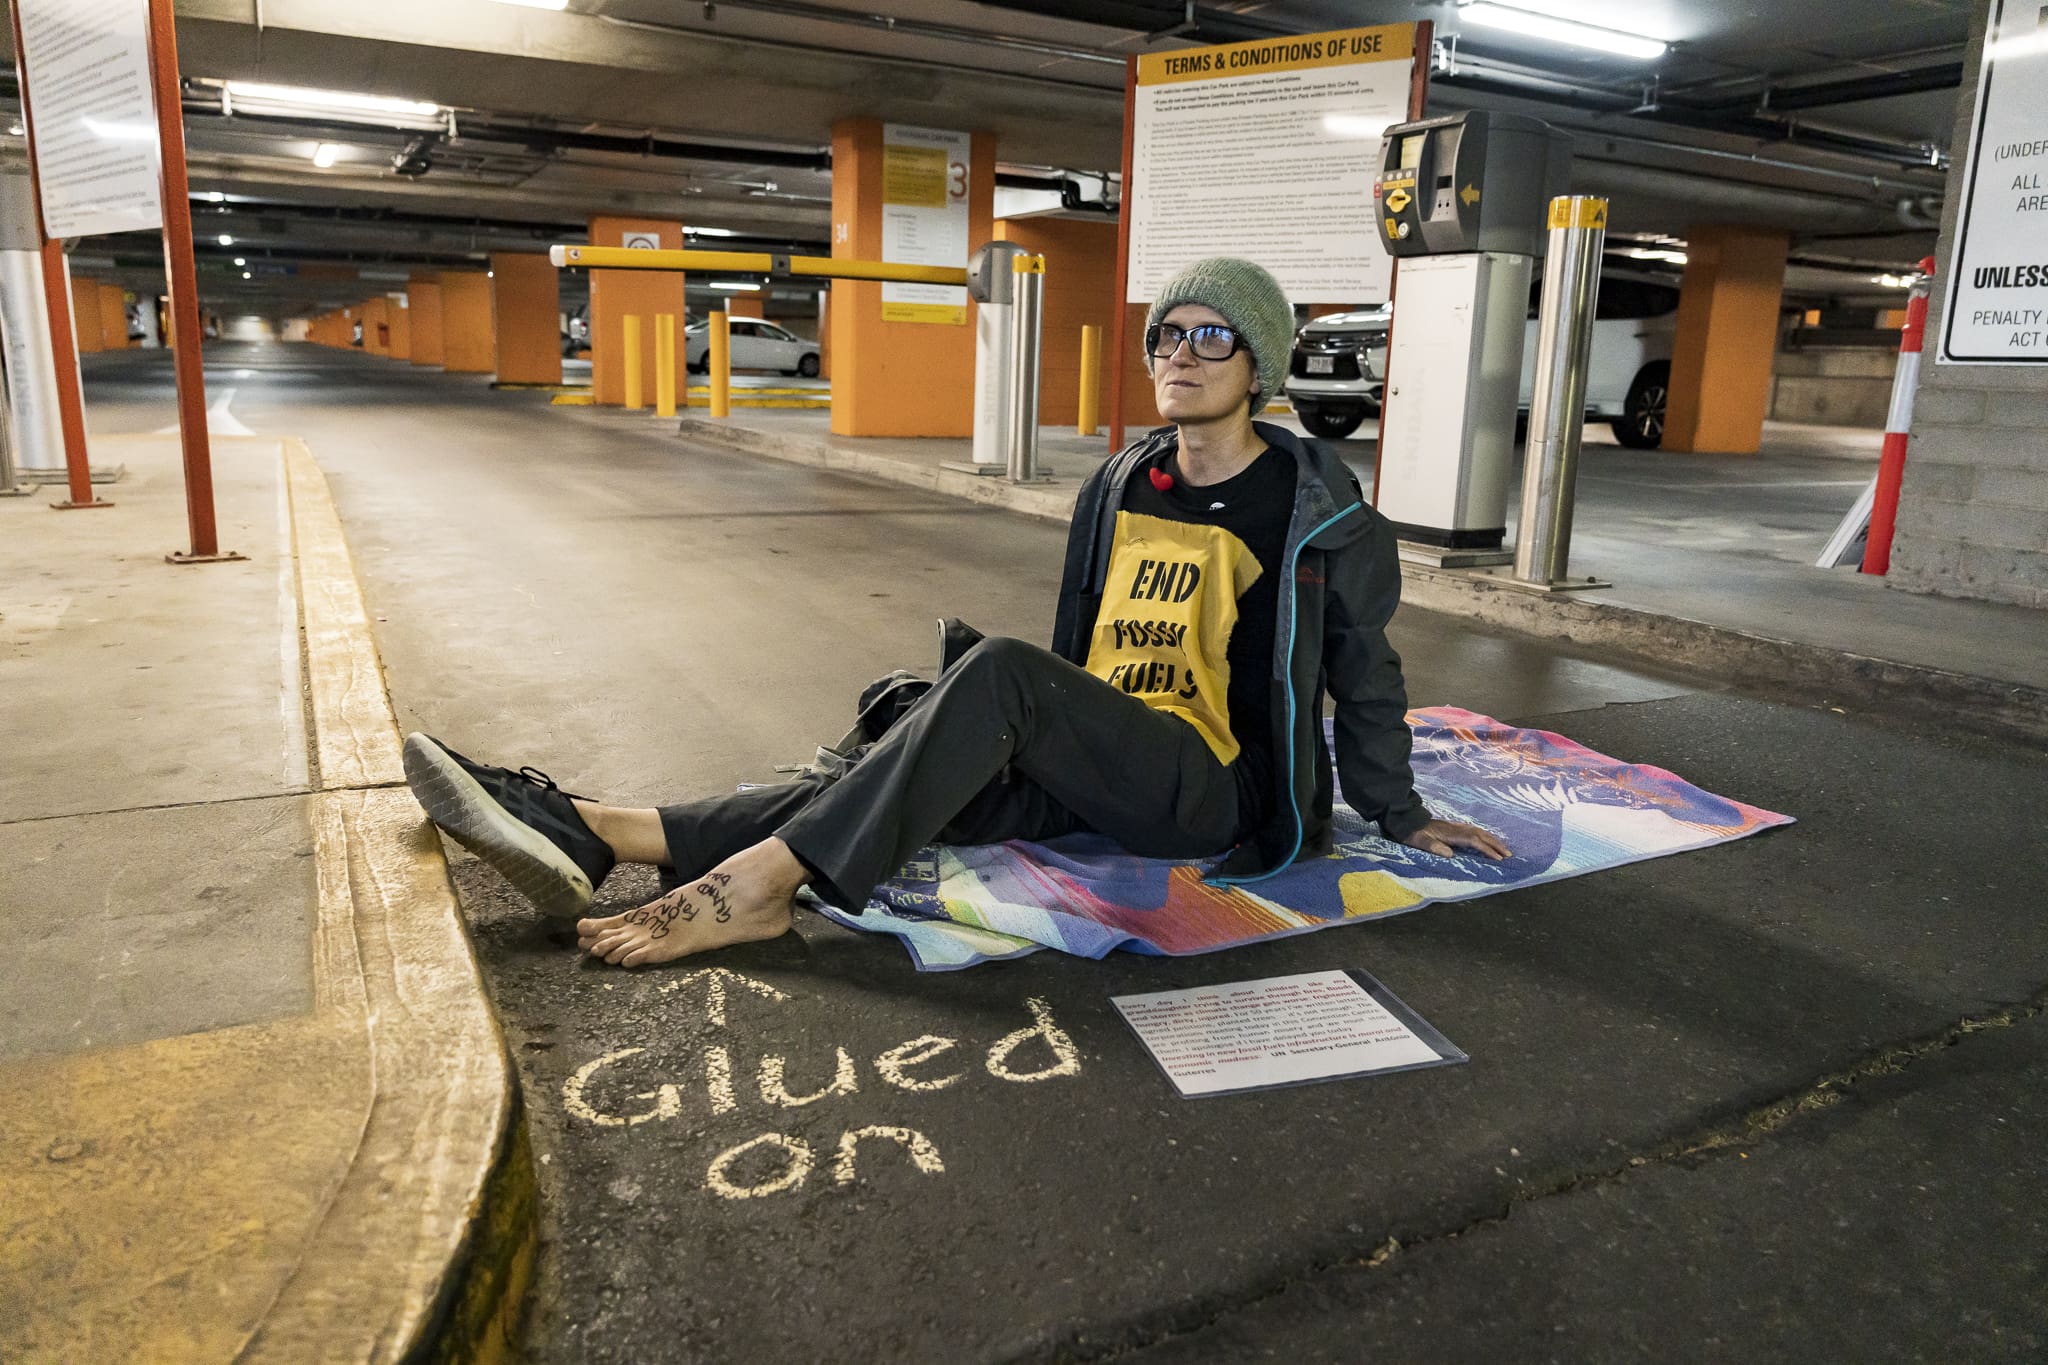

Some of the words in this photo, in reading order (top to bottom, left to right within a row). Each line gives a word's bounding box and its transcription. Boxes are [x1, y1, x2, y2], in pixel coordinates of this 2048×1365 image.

[1165, 53, 1211, 75] TERMS
[1214, 53, 1225, 69] &
[1230, 41, 1322, 68] CONDITIONS
[1327, 38, 1347, 57] OF
[1351, 34, 1383, 55] USE
[948, 161, 968, 198] 3
[2011, 174, 2041, 190] ALL
[2016, 194, 2048, 212] ARE
[1974, 265, 2048, 289] UNLESS
[1973, 310, 2042, 325] PENALTY
[2009, 332, 2041, 347] ACT
[1130, 559, 1200, 603] END
[1107, 662, 1198, 699] FUELS
[624, 908, 670, 939] GLUED
[653, 903, 680, 921] ON
[561, 996, 1083, 1127] Glued
[704, 1124, 946, 1199] on
